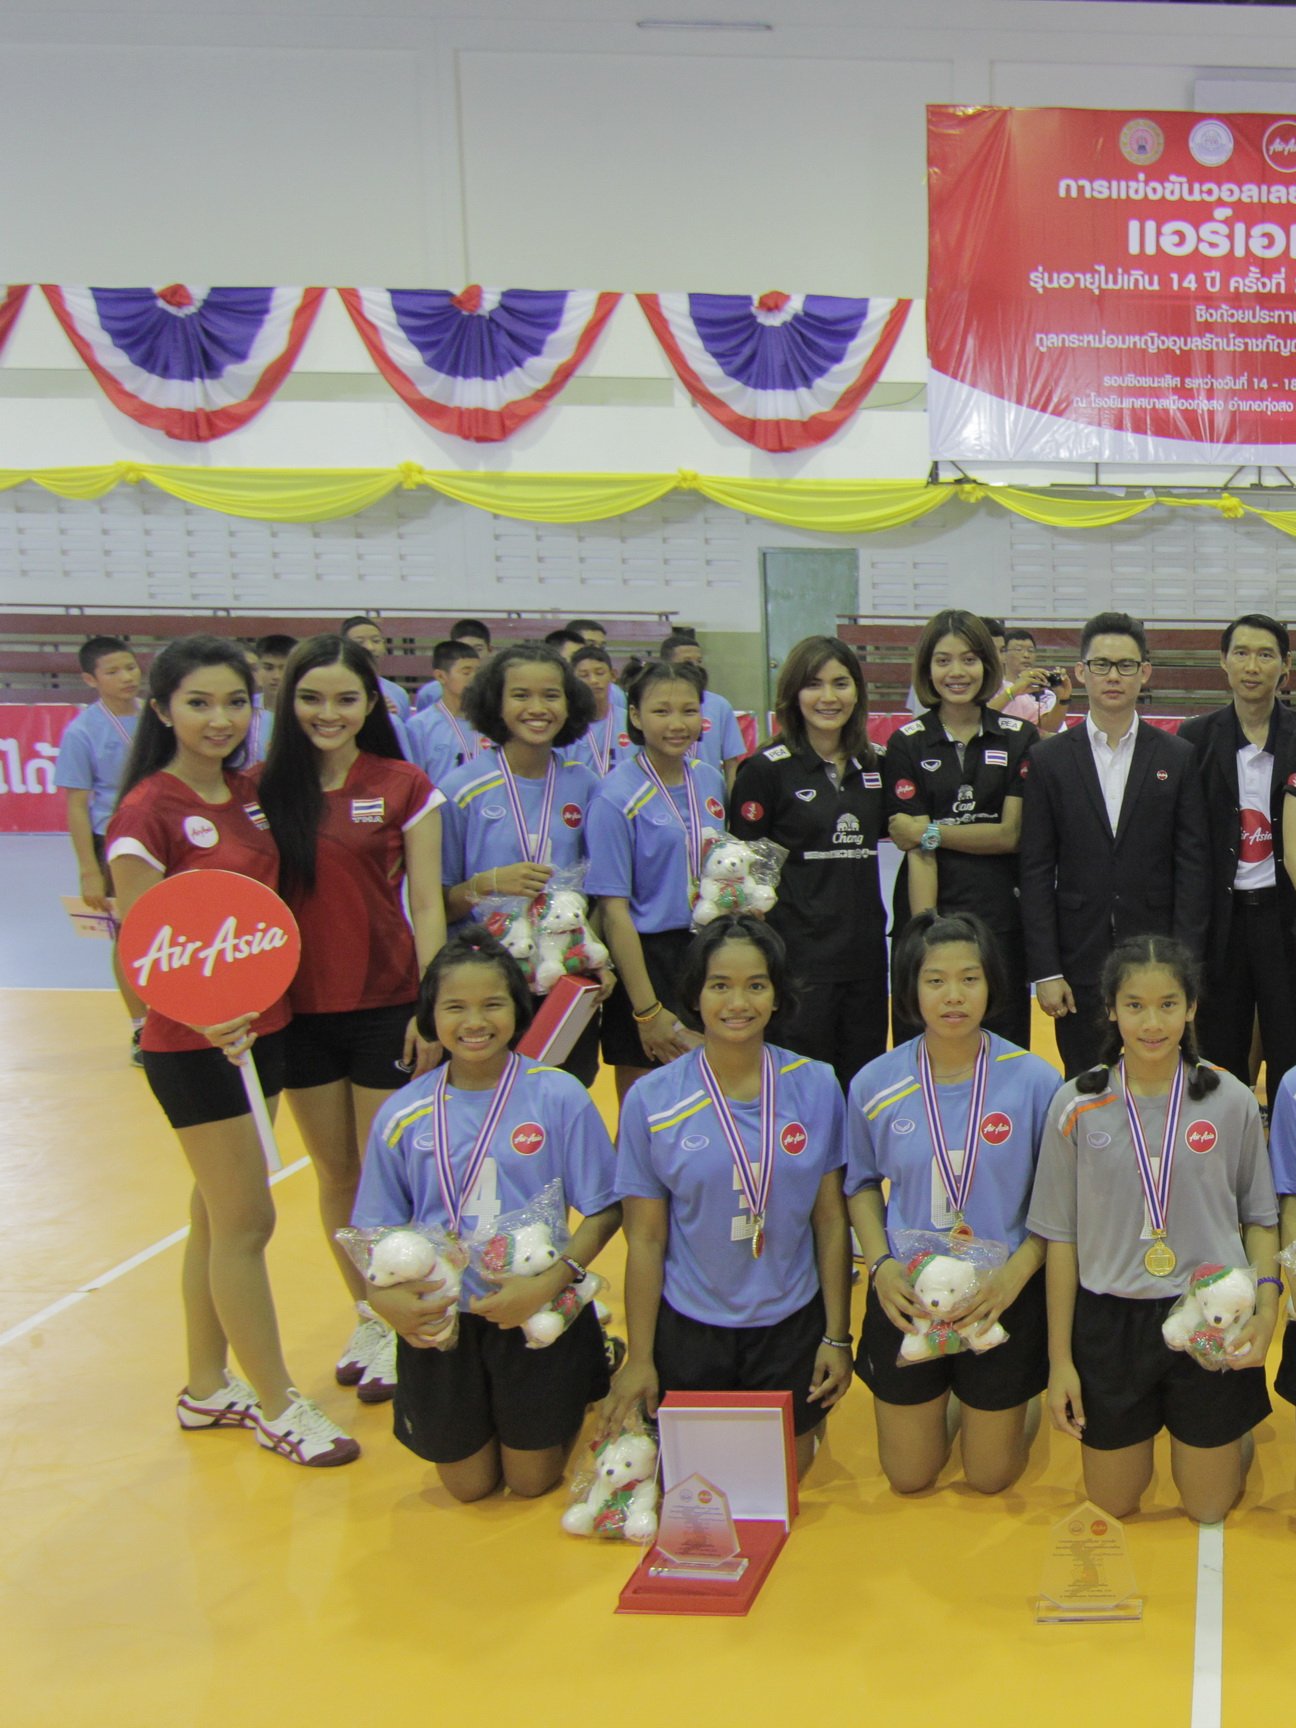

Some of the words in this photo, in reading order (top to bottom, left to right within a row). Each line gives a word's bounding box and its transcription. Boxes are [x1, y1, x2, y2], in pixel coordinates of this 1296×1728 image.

[1029, 264, 1160, 295] รุ่นอายุไม่เกิน
[1169, 272, 1198, 292] 14
[1203, 270, 1221, 293] ปี
[1229, 266, 1286, 294] ครั้งที่
[1252, 378, 1268, 390] 14
[1000, 719, 1018, 730] PEA
[832, 831, 864, 845] Chang
[461, 1157, 501, 1240] 4
